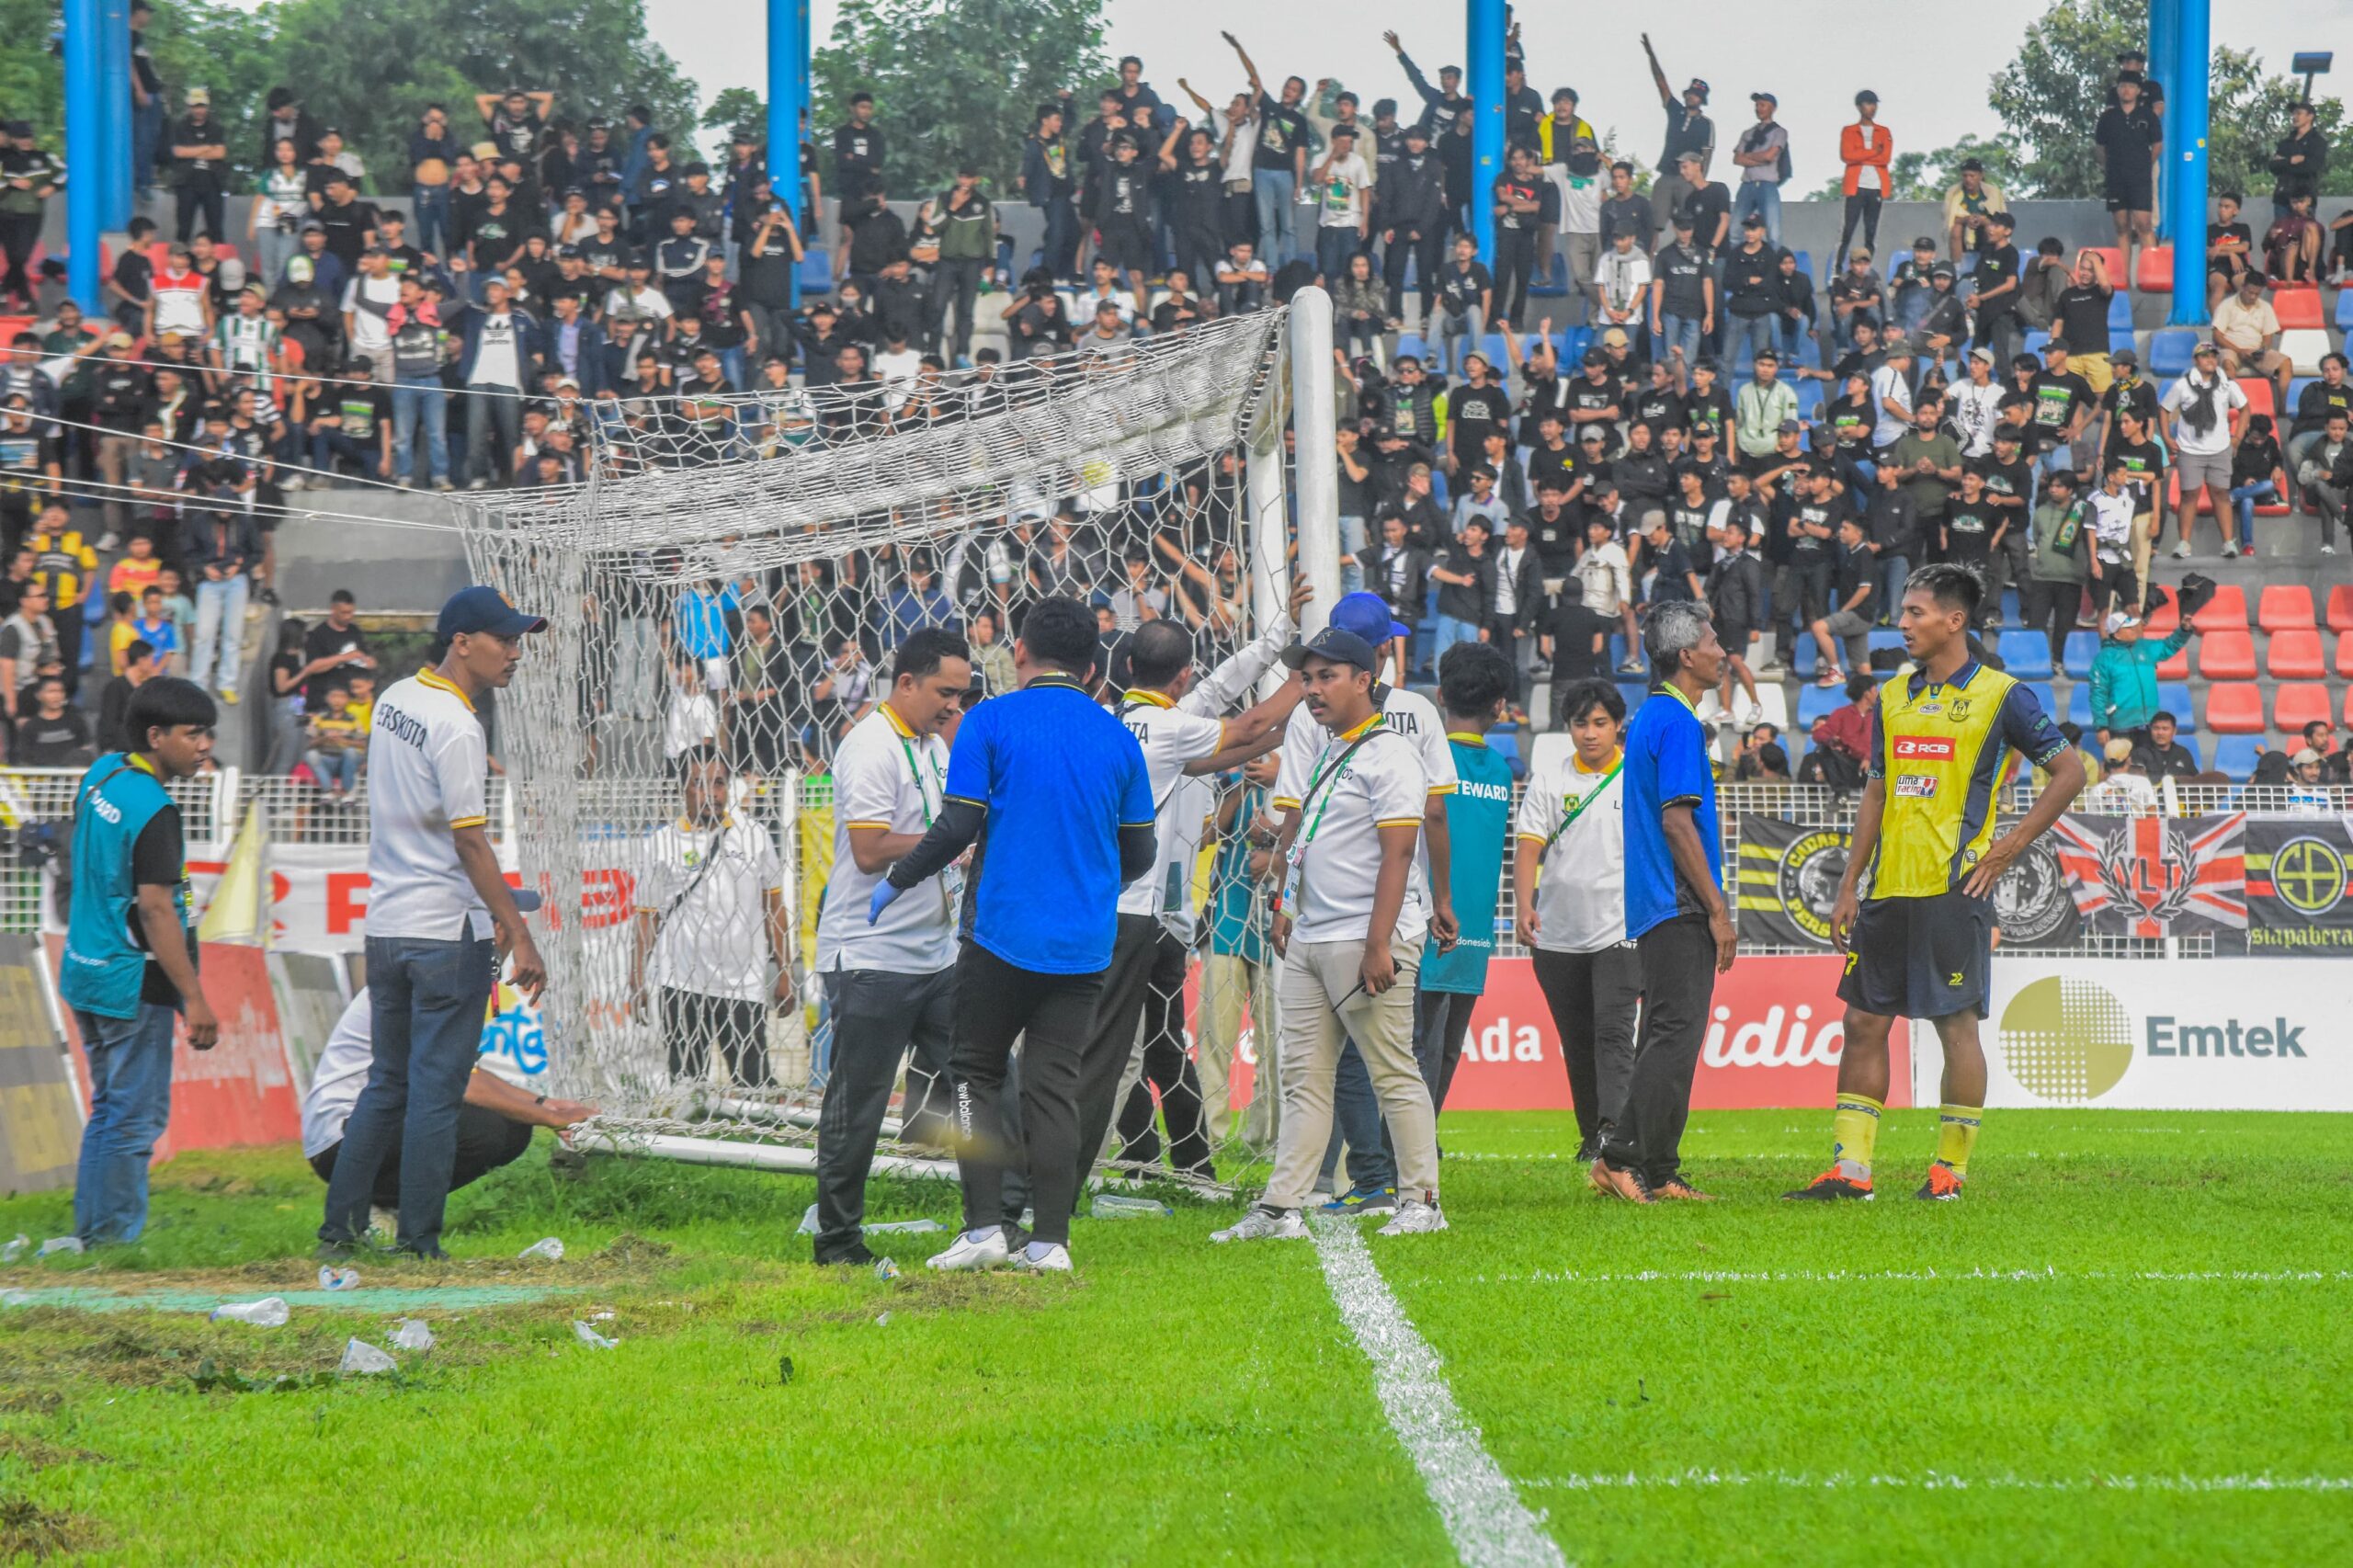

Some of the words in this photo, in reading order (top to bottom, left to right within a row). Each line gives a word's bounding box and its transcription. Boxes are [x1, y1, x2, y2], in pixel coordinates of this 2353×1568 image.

[1917, 744, 1949, 754] RCB
[1898, 776, 1918, 785] uma
[1454, 779, 1507, 801] TEWARD
[1897, 785, 1921, 795] racing
[2116, 857, 2178, 893] YLT
[2145, 1016, 2309, 1058] Emtek
